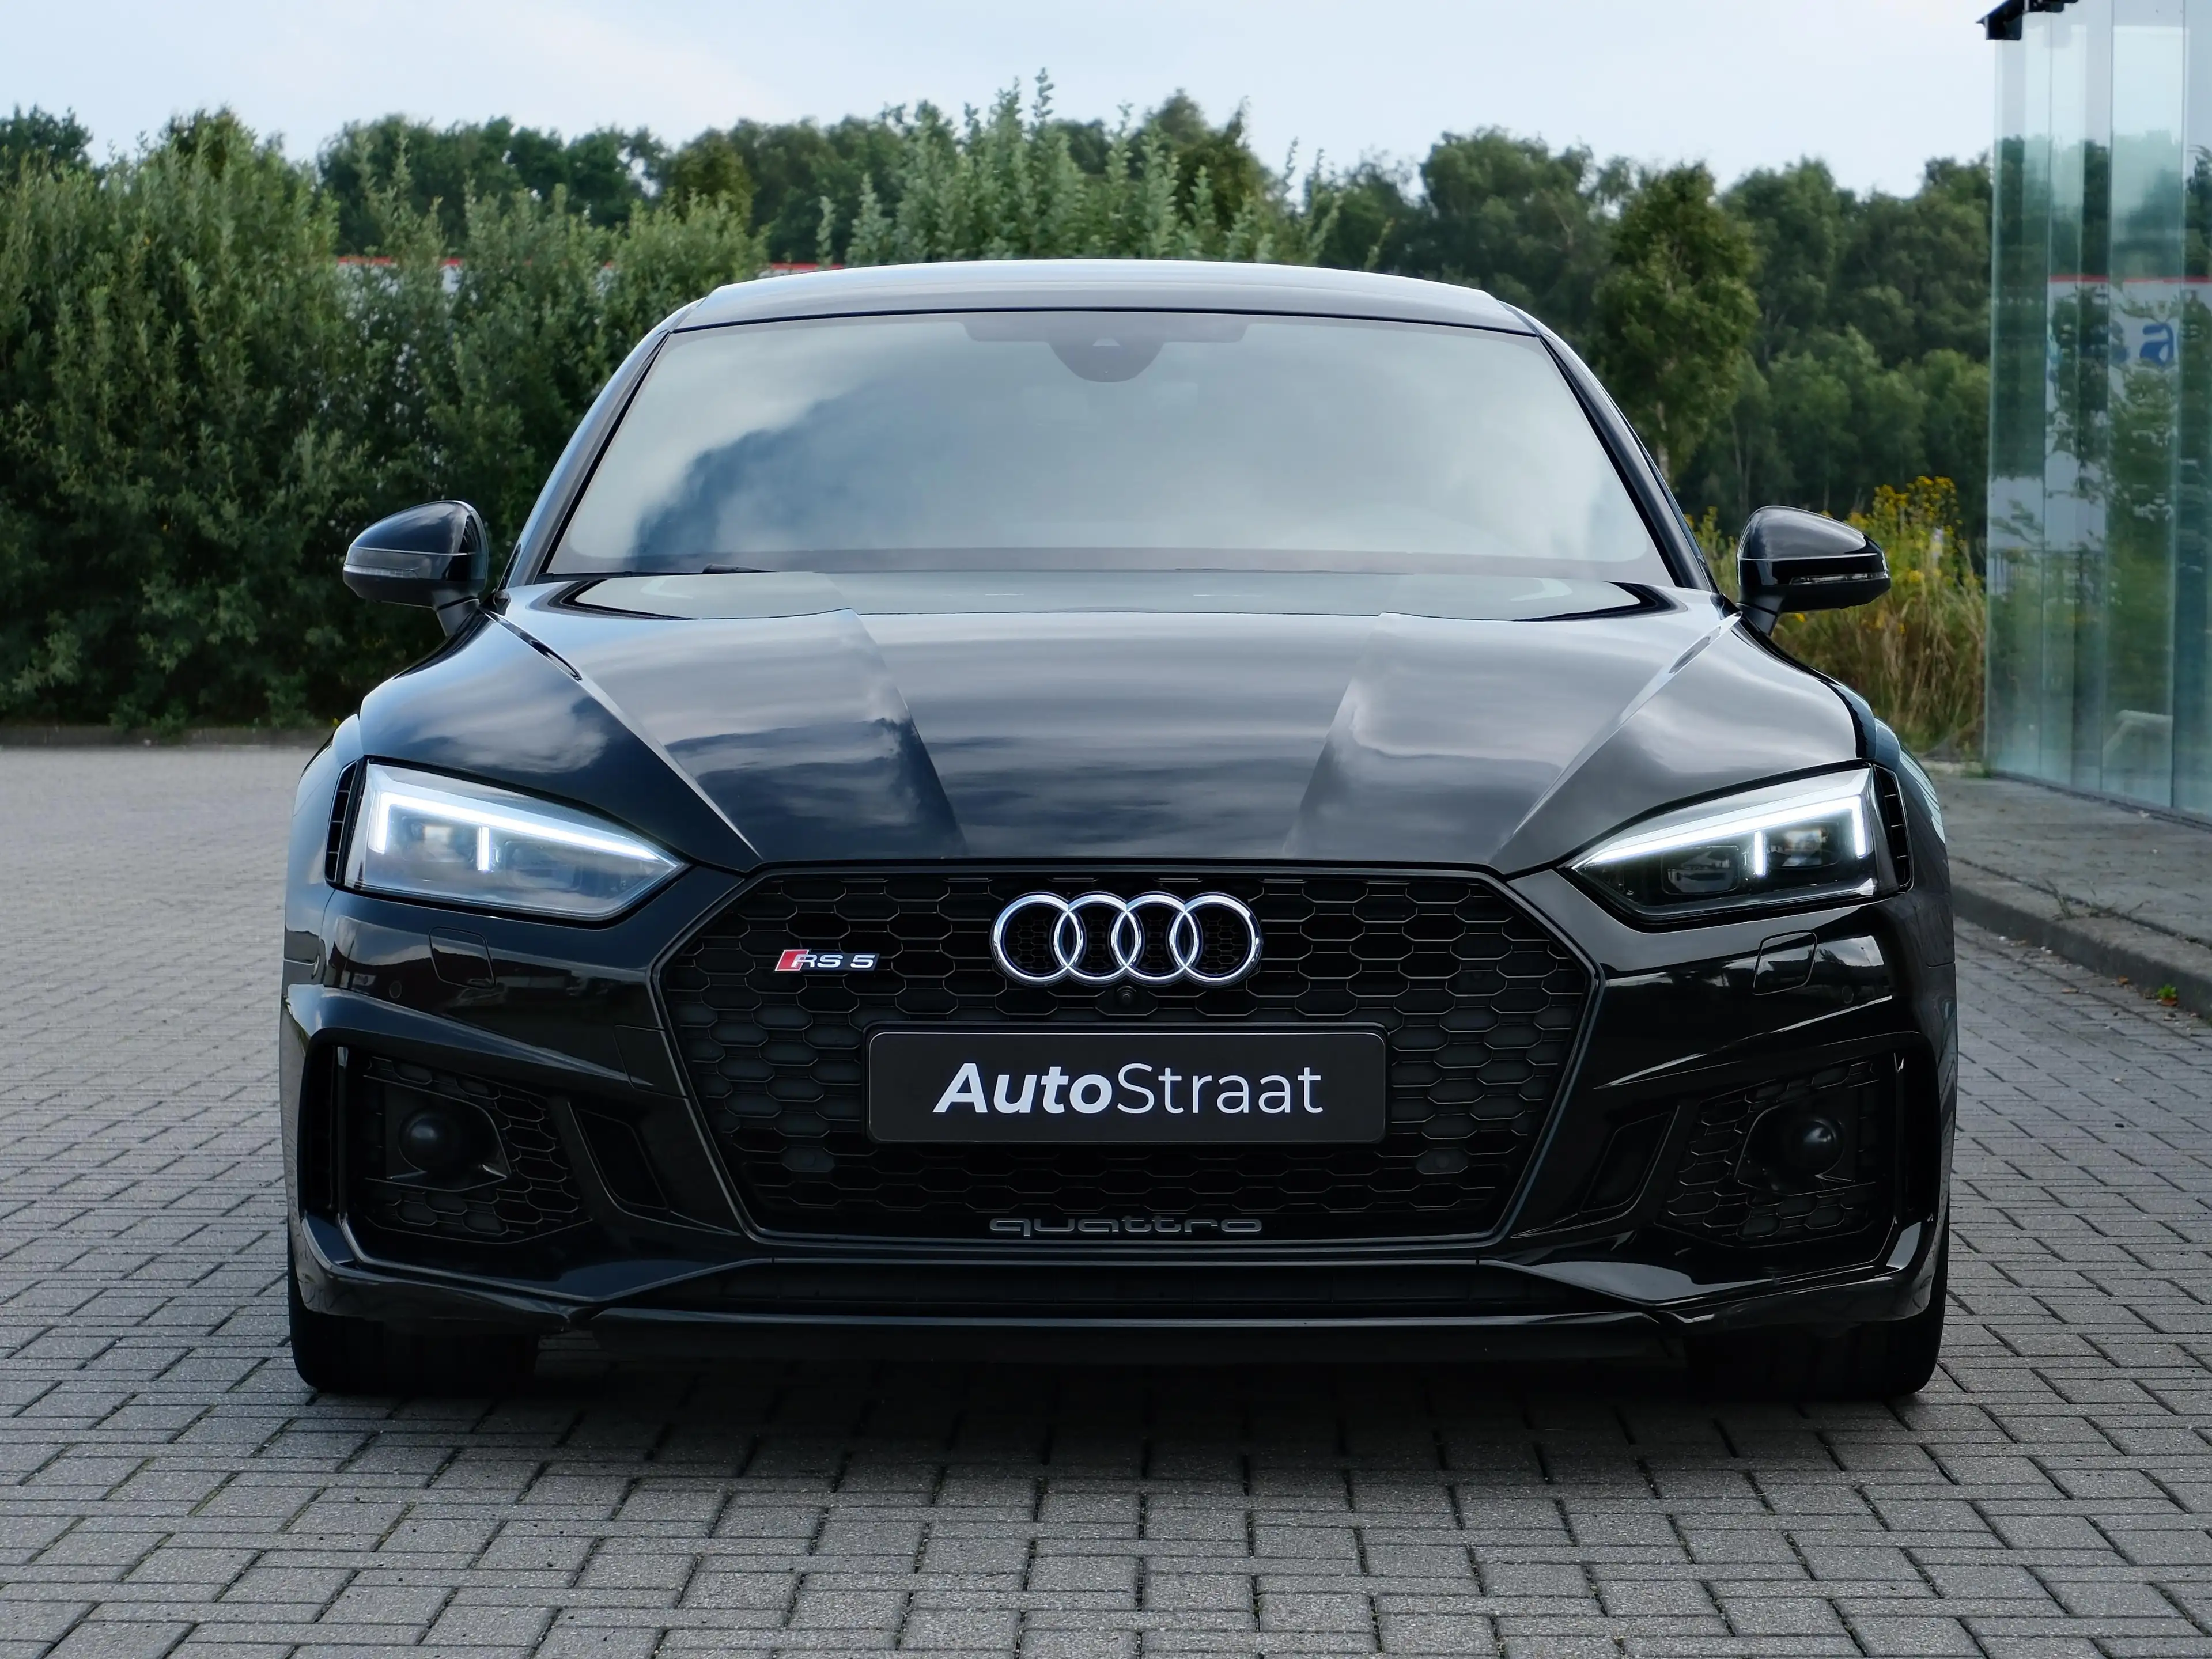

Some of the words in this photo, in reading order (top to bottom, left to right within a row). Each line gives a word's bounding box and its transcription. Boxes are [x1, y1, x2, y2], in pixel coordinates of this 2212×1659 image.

[790, 953, 844, 968] RS
[850, 954, 876, 969] 5
[932, 1062, 1324, 1114] AutoStraat
[989, 1215, 1262, 1237] quattro
